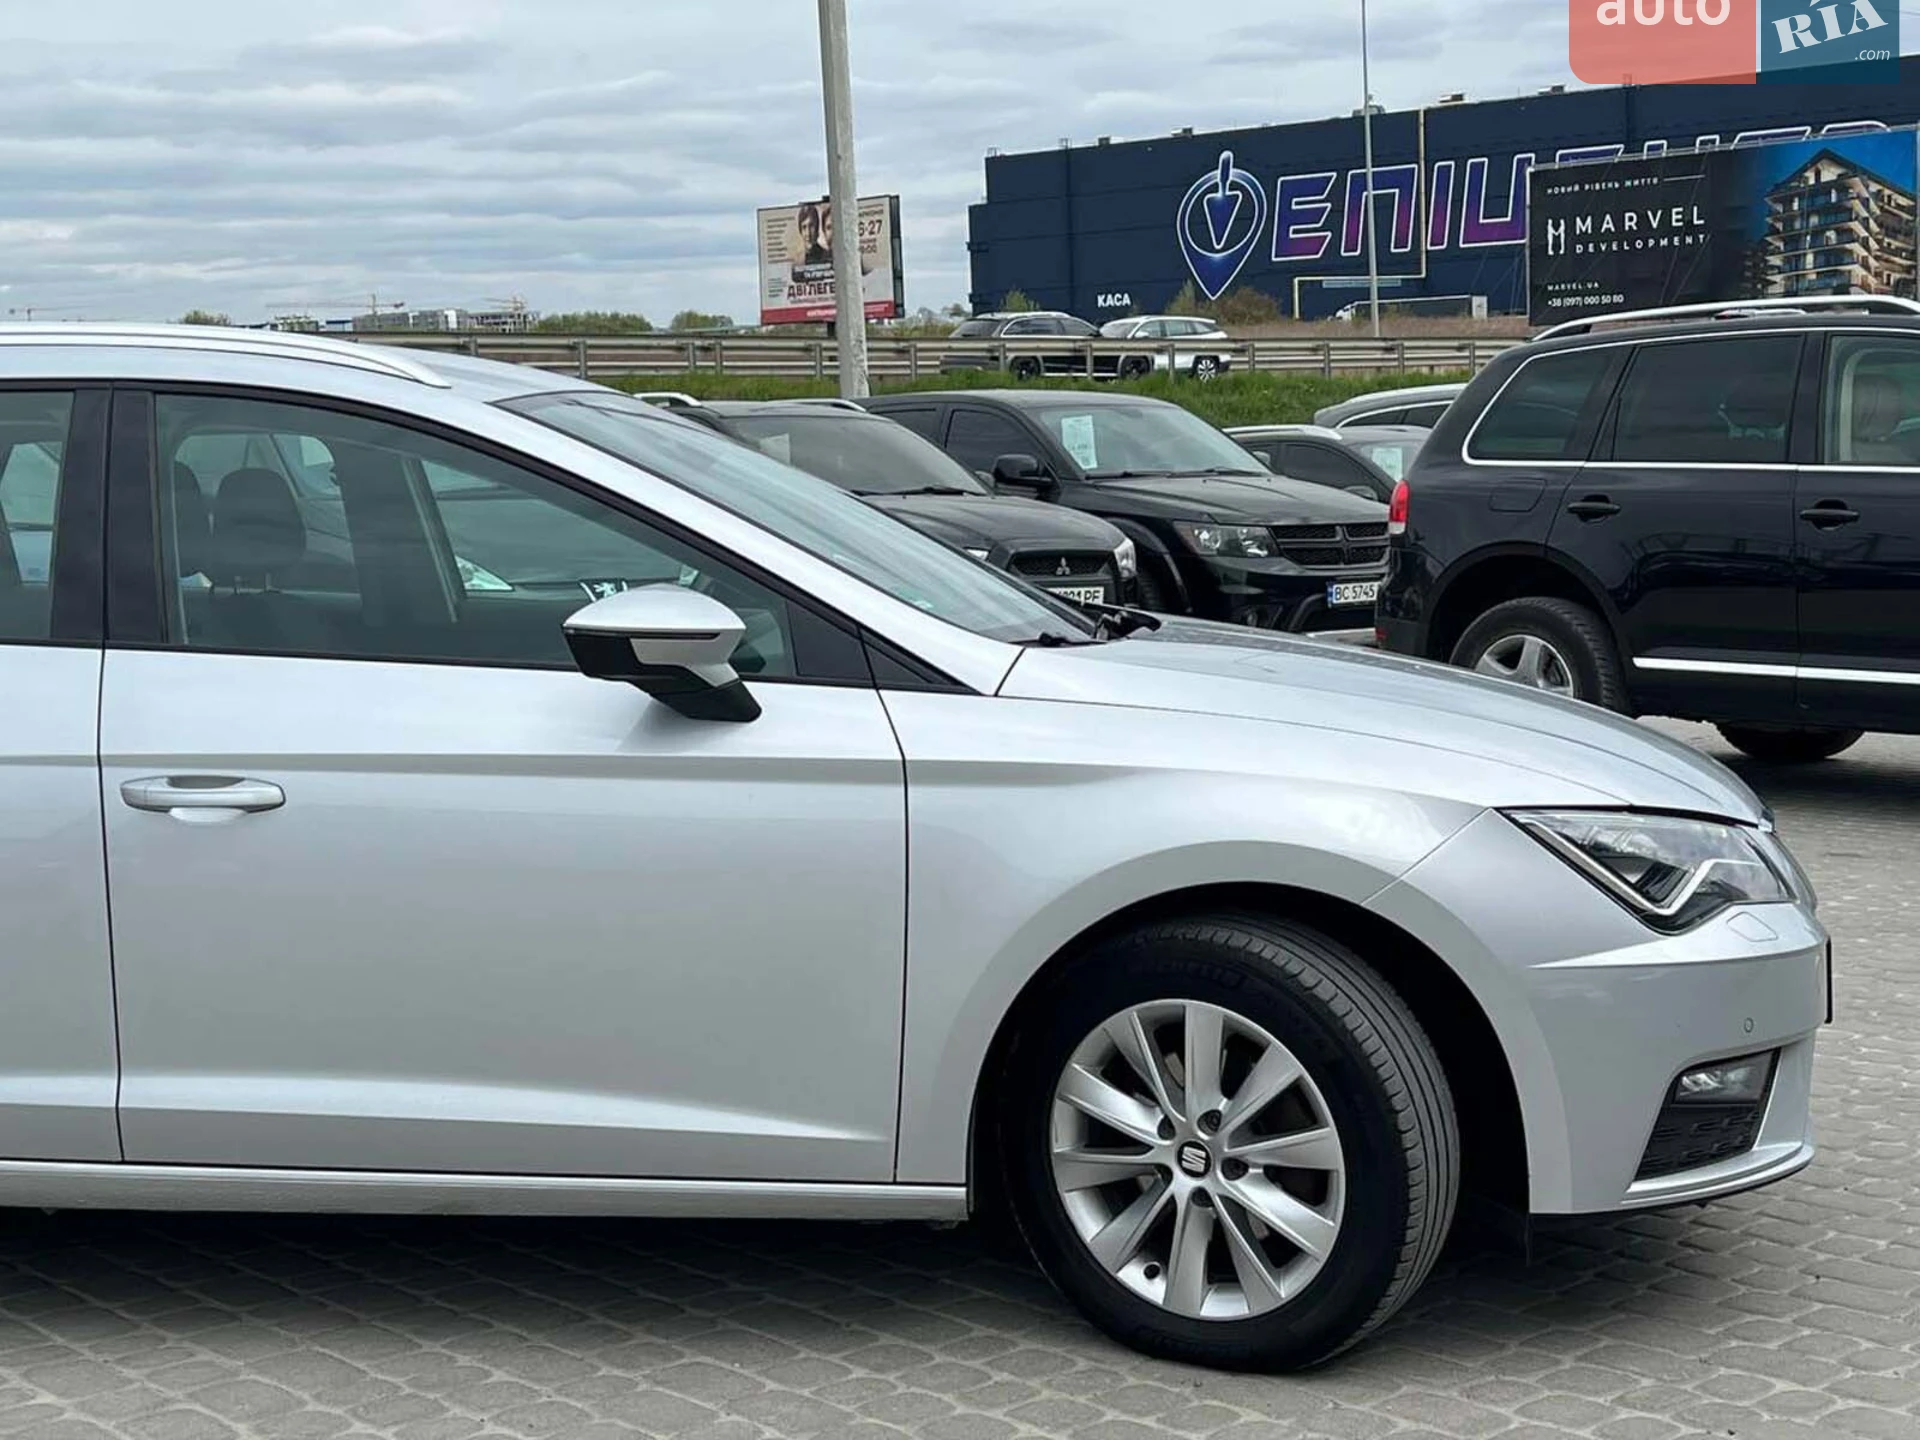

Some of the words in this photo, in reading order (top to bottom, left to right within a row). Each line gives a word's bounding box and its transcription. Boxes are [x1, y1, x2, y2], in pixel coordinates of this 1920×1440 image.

[1575, 205, 1705, 236] MARVEL
[1575, 234, 1706, 254] DEVELOPMENT
[1335, 585, 1350, 601] BC
